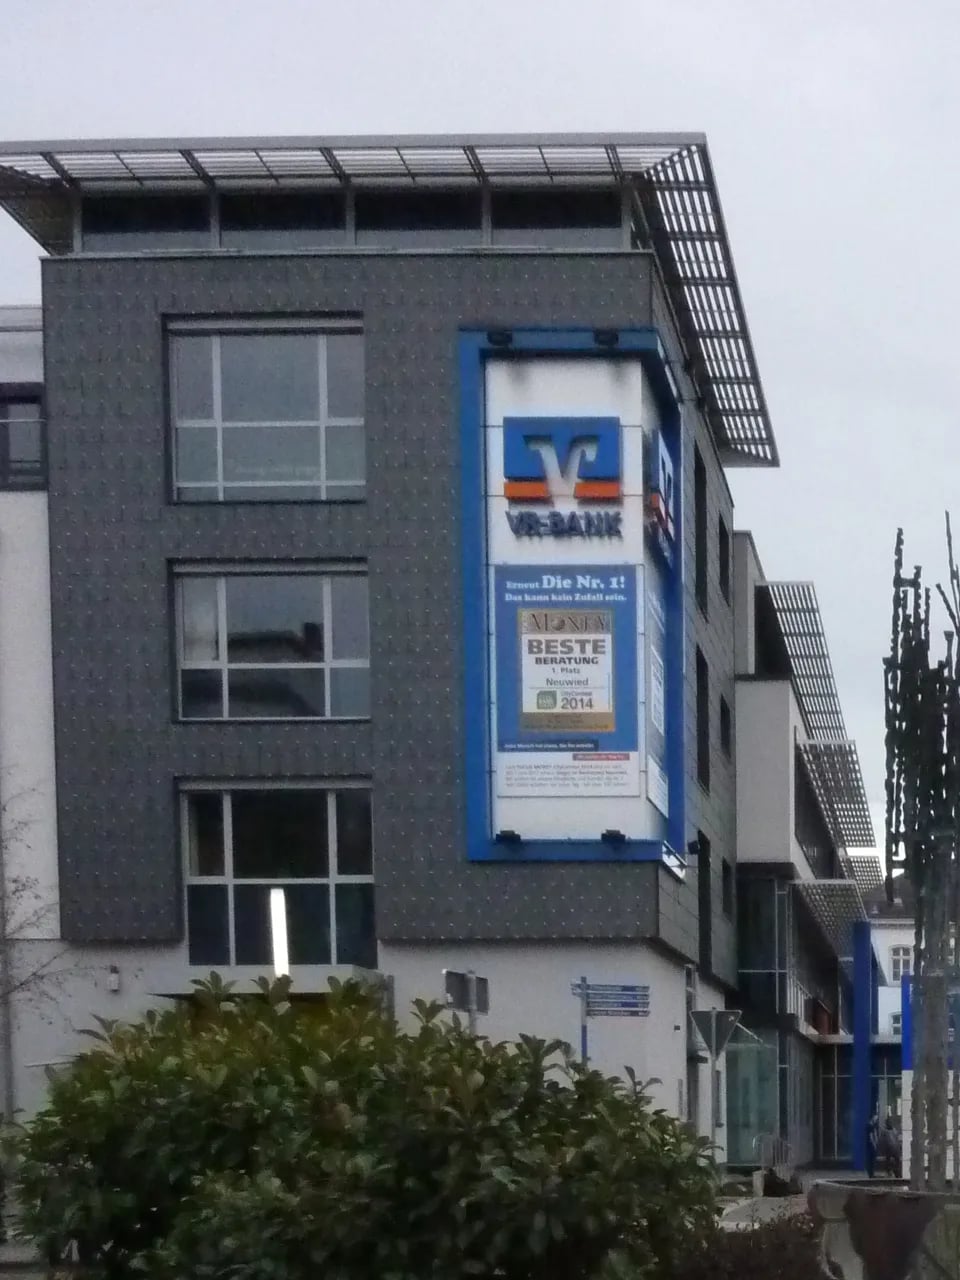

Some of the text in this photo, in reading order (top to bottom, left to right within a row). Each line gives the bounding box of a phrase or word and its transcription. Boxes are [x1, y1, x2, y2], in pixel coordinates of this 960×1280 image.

[505, 511, 622, 538] VR-BANK
[542, 575, 572, 589] Die
[576, 575, 604, 589] Nr.
[609, 575, 625, 589] 1!
[505, 593, 521, 601] Das
[523, 593, 550, 601] kann
[574, 593, 603, 601] Zufall
[605, 593, 627, 601] sein.
[528, 639, 606, 655] BESTE
[535, 657, 599, 665] BERATUNG
[546, 678, 588, 686] Neuwied
[561, 698, 593, 710] 2014
